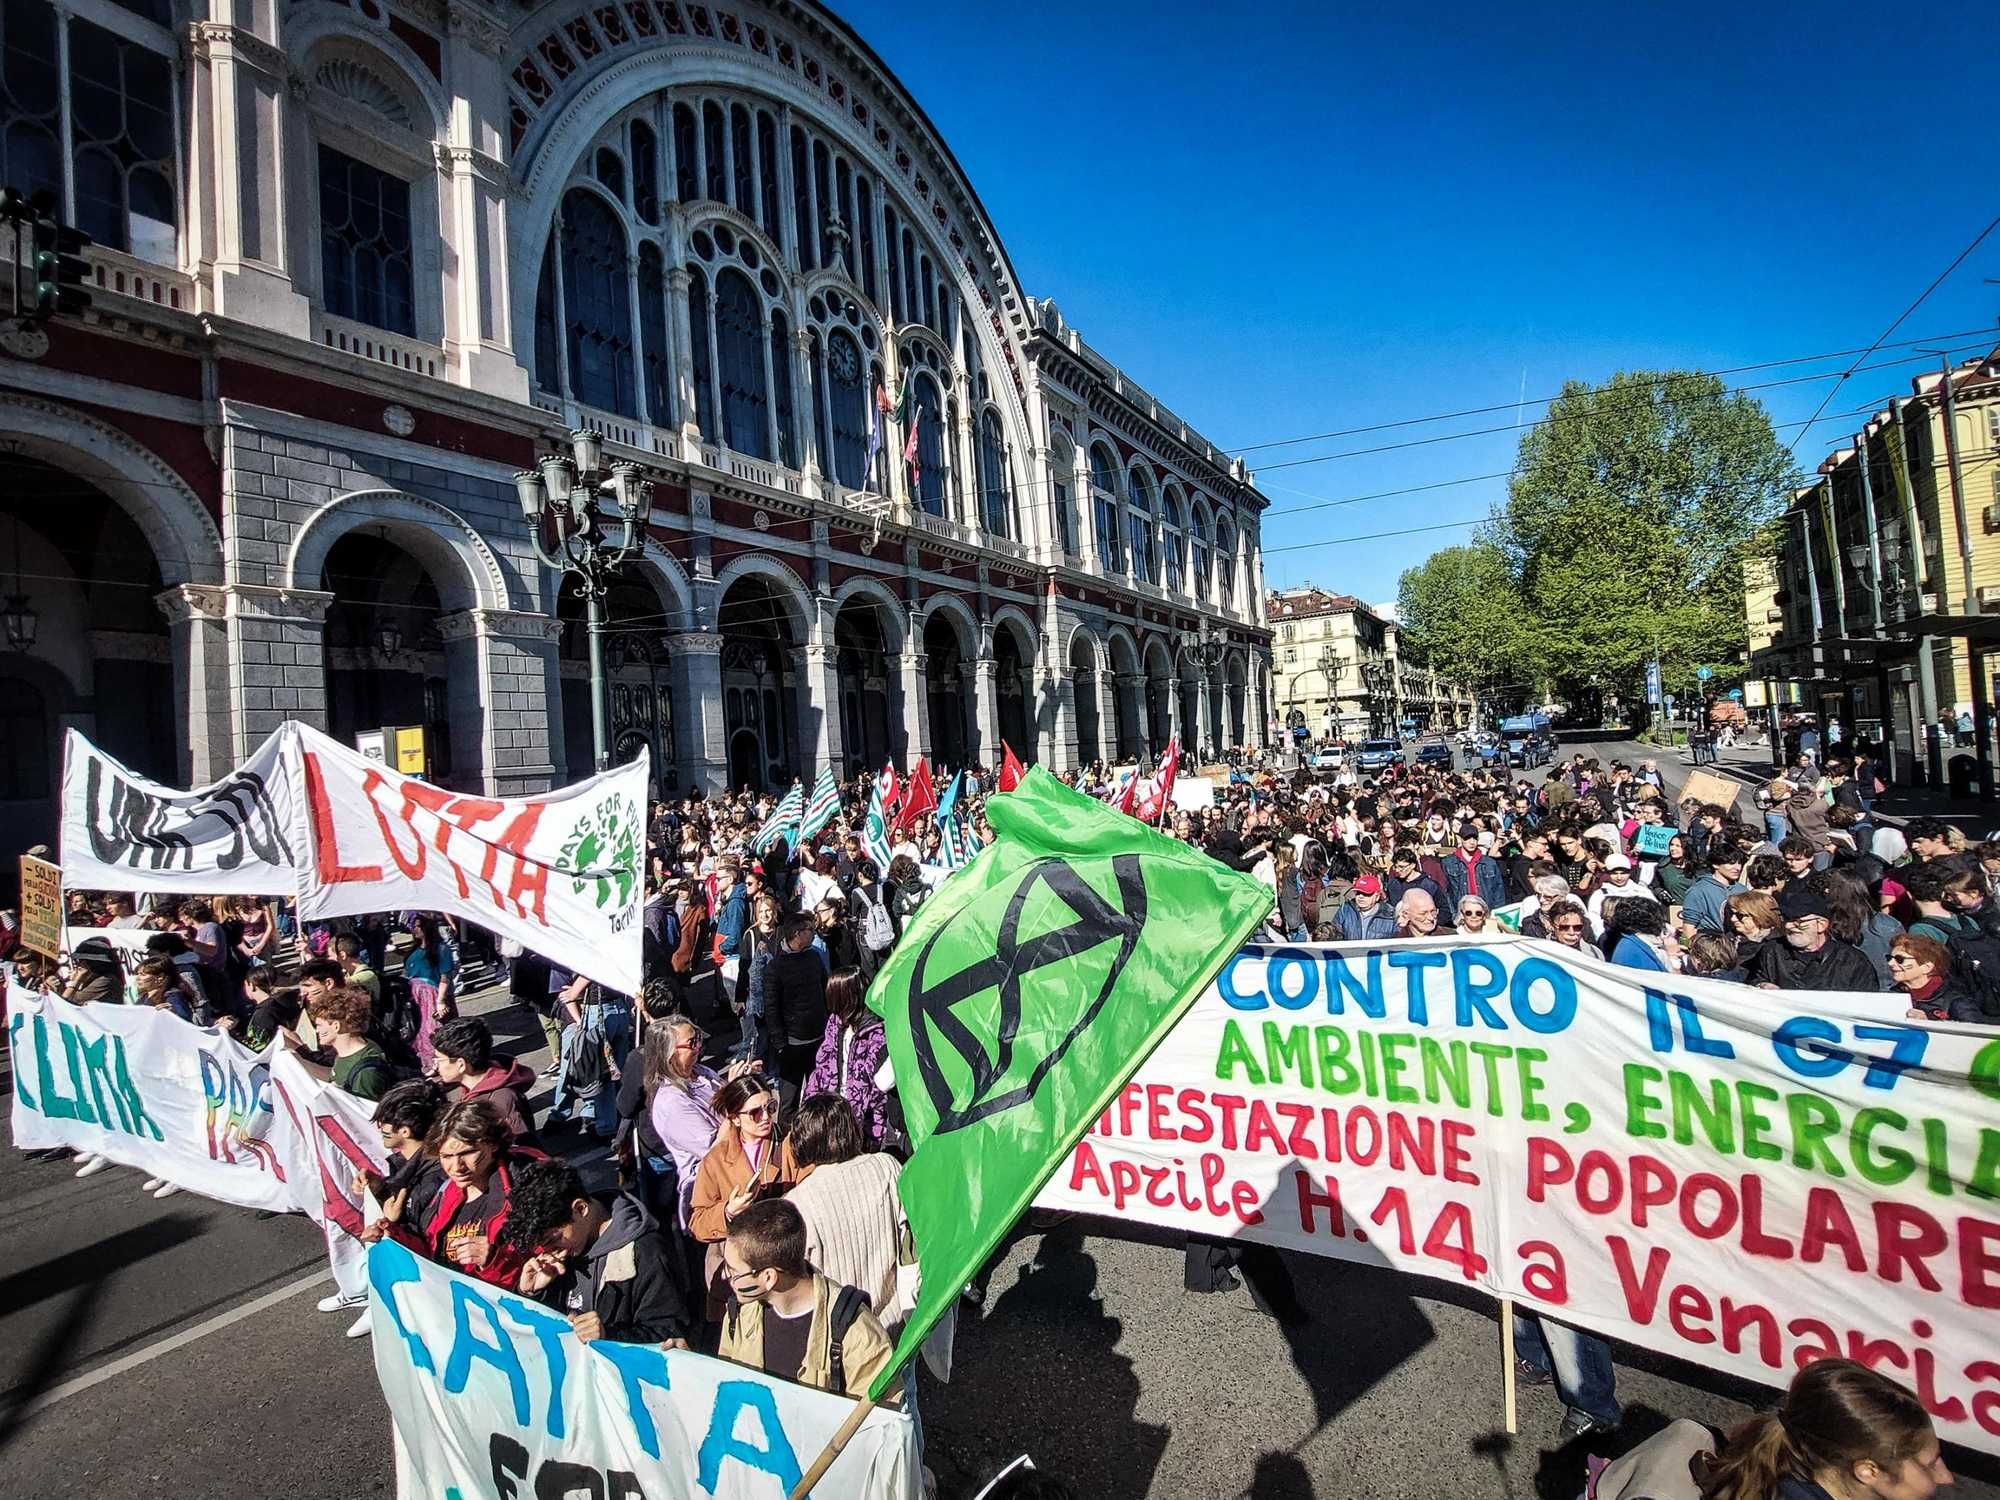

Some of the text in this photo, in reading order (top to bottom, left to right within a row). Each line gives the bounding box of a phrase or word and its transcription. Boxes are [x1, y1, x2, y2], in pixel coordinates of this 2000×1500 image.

[302, 751, 550, 927] LUTTA
[596, 791, 622, 820] FOR
[10, 1012, 165, 1142] CLIMA
[1215, 1018, 1592, 1134] AMBIENTE,
[1216, 945, 1578, 1034] CONTRO
[1641, 985, 1736, 1060] IL
[1771, 1014, 1931, 1091] G7
[1069, 1141, 1265, 1226] Aprile
[1517, 1239, 1569, 1305] a
[1088, 1082, 2000, 1310] IFESTAZIONE POPOLARE
